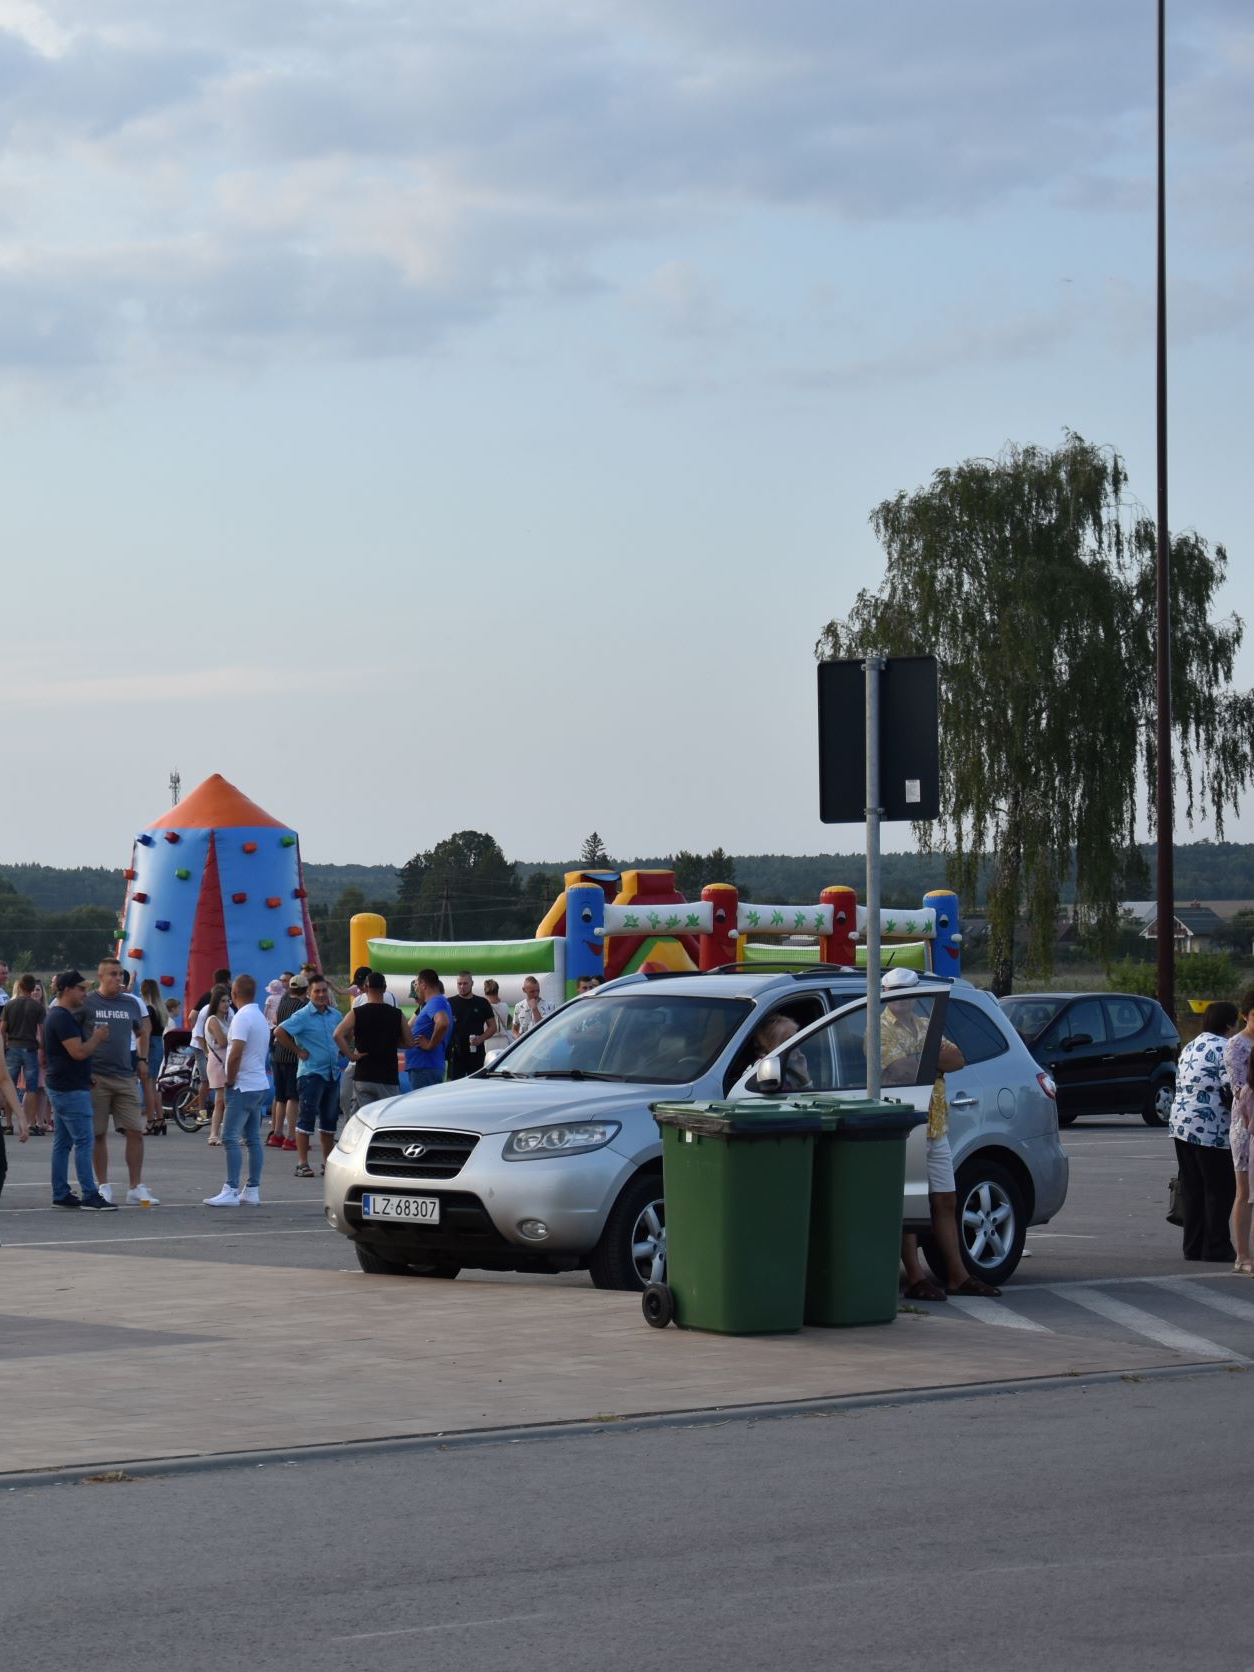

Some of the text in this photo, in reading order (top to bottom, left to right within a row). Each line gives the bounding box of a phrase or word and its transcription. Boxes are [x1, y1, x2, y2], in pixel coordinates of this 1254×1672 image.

[96, 1010, 129, 1019] HILFIGER
[372, 1198, 437, 1218] LZ 68307
